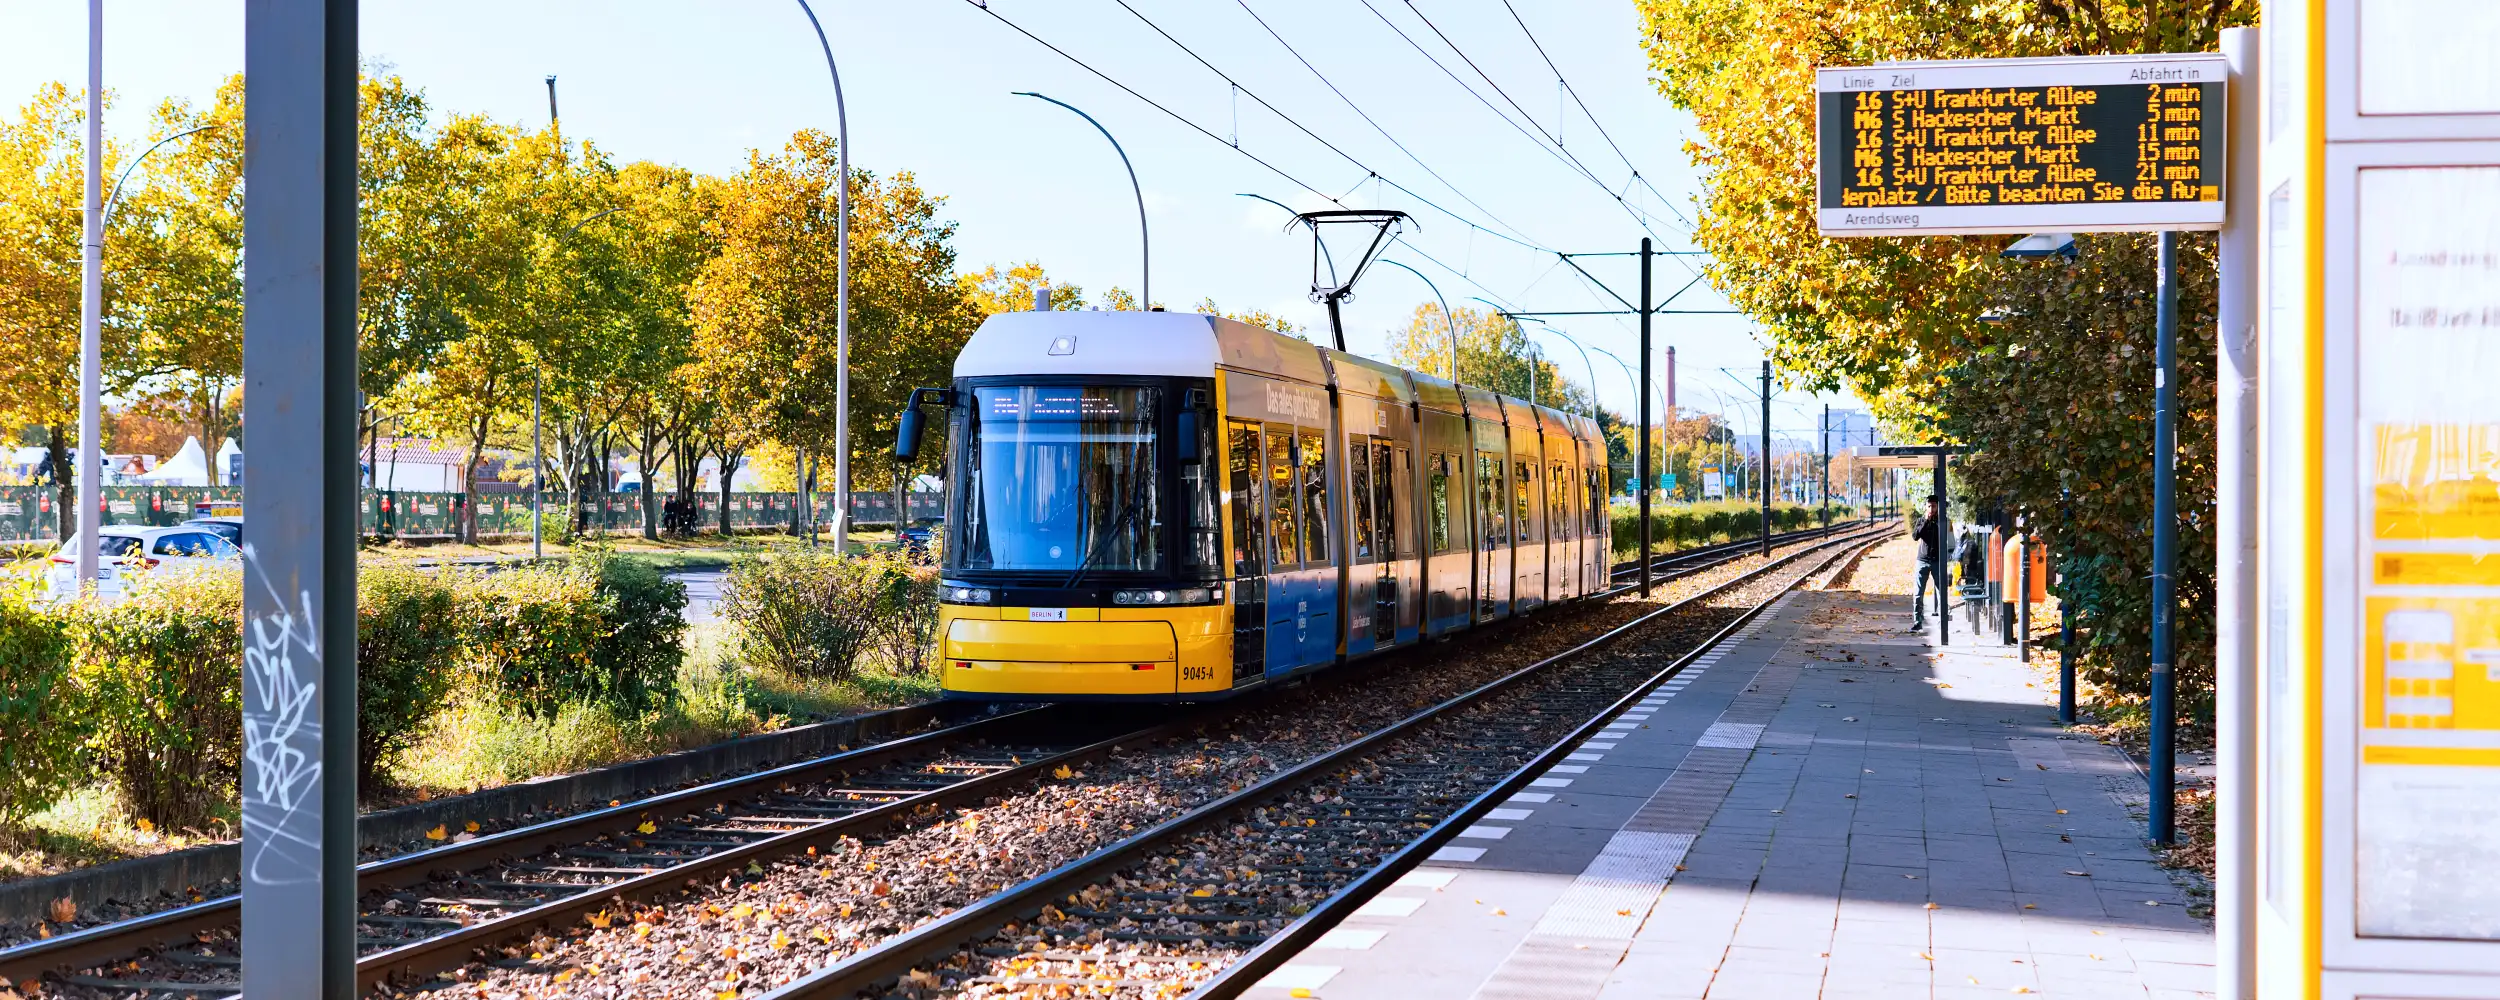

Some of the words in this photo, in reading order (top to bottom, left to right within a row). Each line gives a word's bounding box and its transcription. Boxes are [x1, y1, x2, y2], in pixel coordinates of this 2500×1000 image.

[1843, 76, 1875, 89] Linie
[1891, 74, 1915, 88] Ziel
[2129, 67, 2183, 81] Abfahrt
[2187, 66, 2200, 80] in
[1855, 91, 1883, 111] 16
[1891, 89, 1927, 110] S+U
[1933, 87, 2040, 109] Frankfurter
[2046, 86, 2097, 106] Allee
[2147, 83, 2161, 103] 2
[2164, 83, 2200, 102] min
[1853, 110, 1883, 130] M6
[1891, 109, 1905, 129] S
[1911, 107, 2017, 128] Hackescher
[2024, 105, 2080, 125] Markt
[2147, 103, 2161, 122] 5
[2164, 102, 2200, 122] min
[1855, 129, 1883, 149] 16
[1892, 128, 1927, 148] S+U
[1934, 126, 2040, 147] Frankfurter
[2046, 125, 2097, 144] Allee
[2137, 123, 2159, 142] 11
[2164, 122, 2200, 141] min
[1853, 148, 1883, 168] M6
[1892, 147, 1905, 167] S
[1911, 146, 2017, 166] Hackescher
[2024, 144, 2080, 164] Markt
[2137, 142, 2161, 161] 15
[2163, 141, 2200, 161] min
[1856, 167, 1884, 187] 16
[1892, 166, 1927, 186] S+U
[1934, 165, 2040, 184] Frankfurter
[2046, 163, 2097, 183] Allee
[2135, 161, 2159, 181] 21
[2163, 161, 2200, 180] min
[1945, 184, 1992, 204] Bitte
[1998, 183, 2086, 203] beachten
[2092, 181, 2125, 201] Sie
[2131, 181, 2164, 200] die
[2170, 180, 2199, 199] Au
[1845, 211, 1920, 228] Arendsweg
[1265, 382, 1279, 414] Das
[1278, 385, 1293, 416] alles
[1182, 665, 1215, 681] 9045-A
